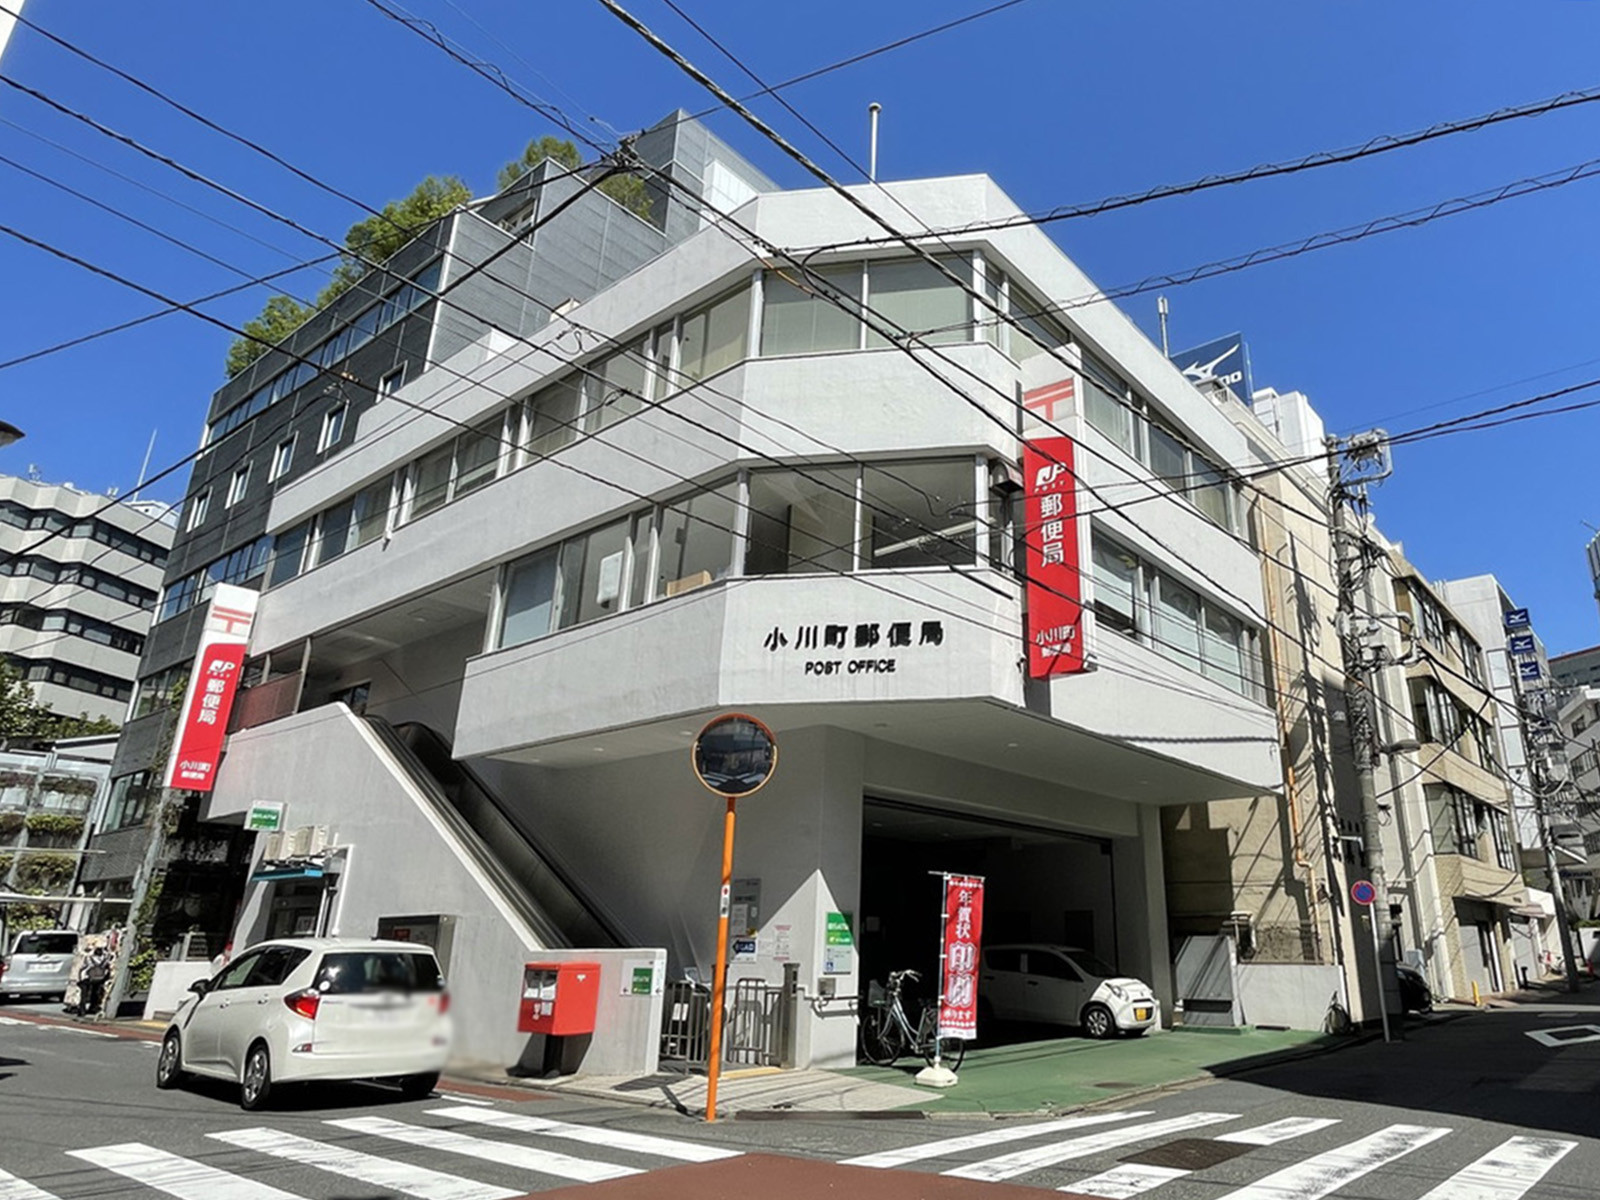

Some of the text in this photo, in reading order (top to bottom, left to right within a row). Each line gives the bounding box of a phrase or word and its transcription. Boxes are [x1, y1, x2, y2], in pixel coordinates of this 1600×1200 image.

[1040, 493, 1064, 568] 郵便局
[764, 621, 945, 651] 小川町郵便局
[1036, 625, 1076, 645] 小川町
[805, 659, 896, 675] POST OFFICE
[197, 678, 225, 725] 郵便局
[956, 890, 972, 939] 年賀状
[946, 941, 976, 1006] 印刷
